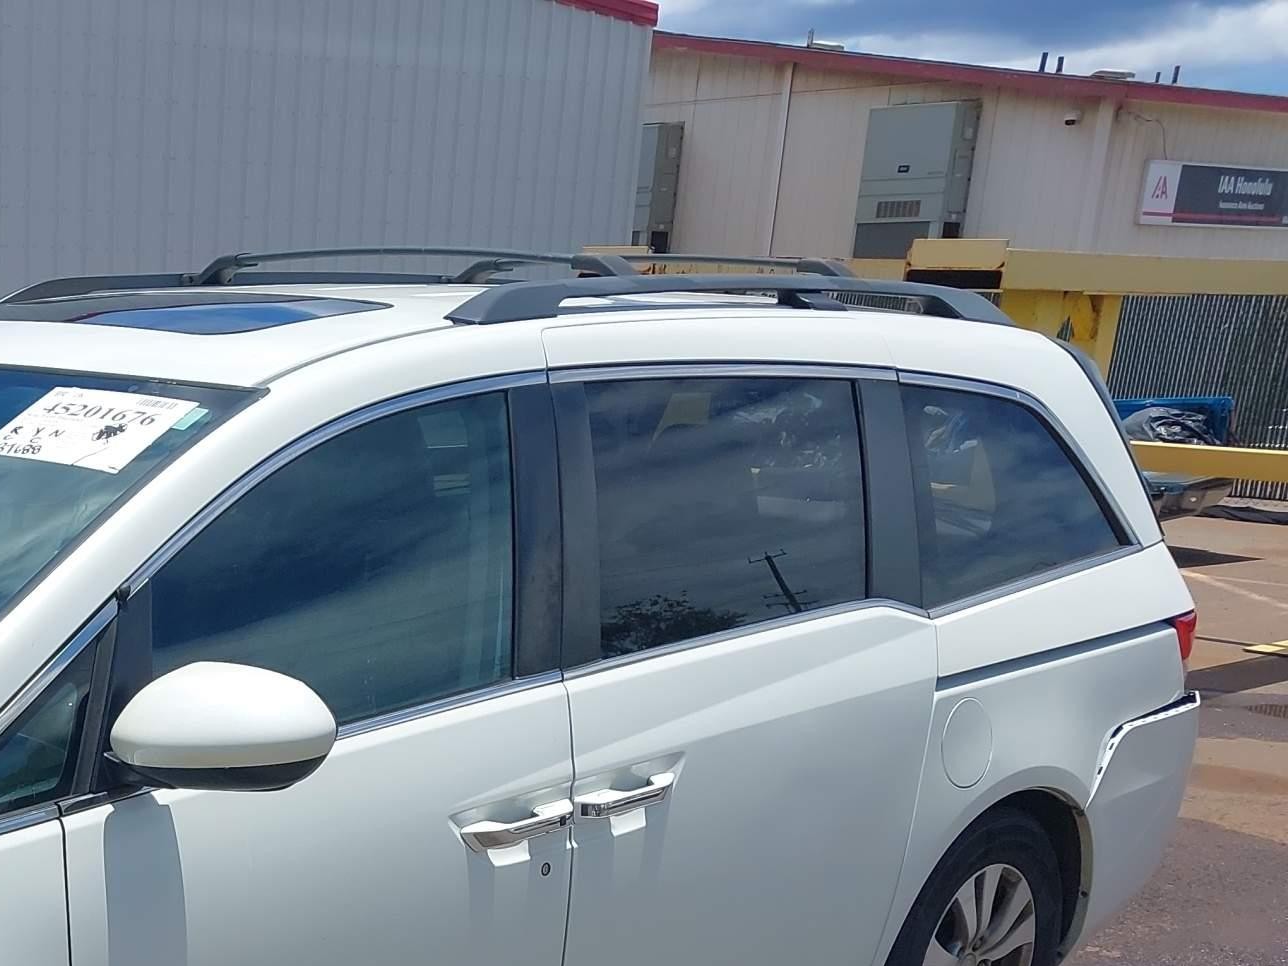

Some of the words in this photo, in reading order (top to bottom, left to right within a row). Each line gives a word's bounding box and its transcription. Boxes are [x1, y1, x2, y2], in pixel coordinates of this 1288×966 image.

[1217, 175, 1235, 194] IAA
[1235, 176, 1274, 197] Honolulu
[43, 402, 161, 426] 45201676
